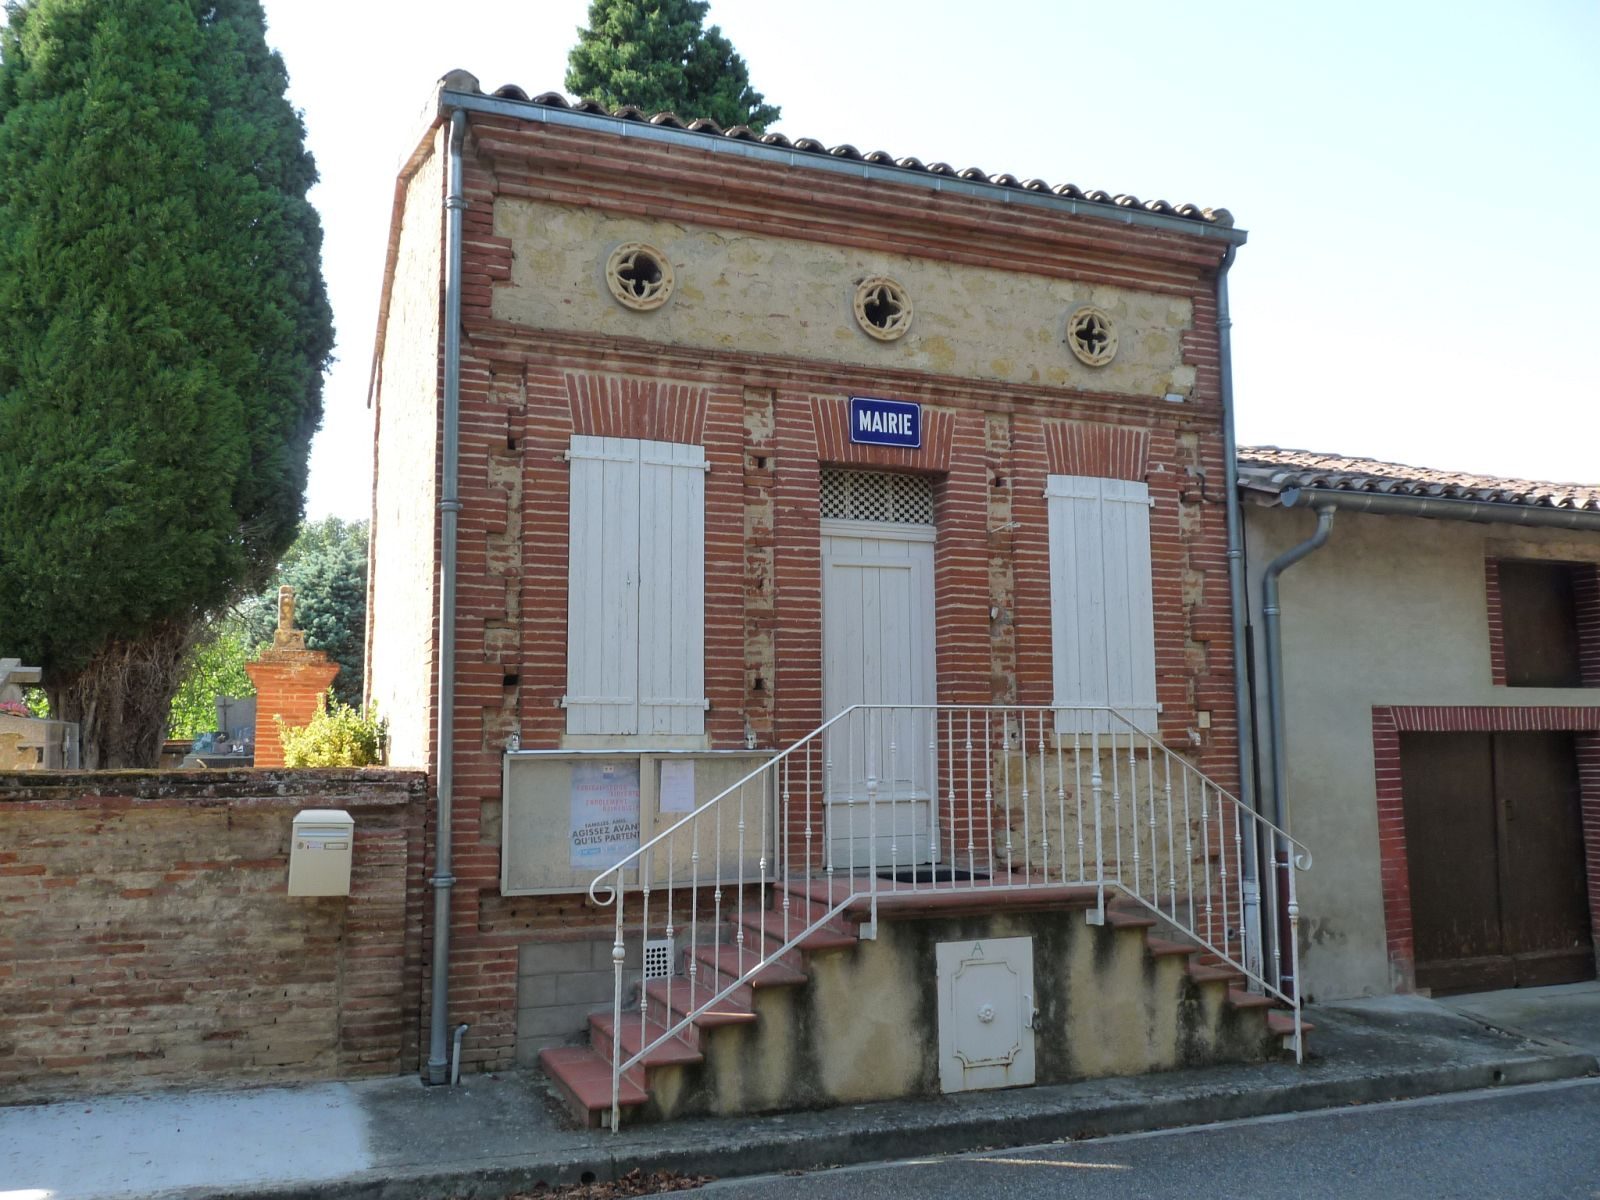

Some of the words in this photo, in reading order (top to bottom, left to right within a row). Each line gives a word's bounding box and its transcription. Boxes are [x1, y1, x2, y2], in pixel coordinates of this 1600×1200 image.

[859, 409, 913, 436] MAIRIE
[572, 827, 610, 838] AGISSEZ
[574, 837, 602, 845] QU'ILS
